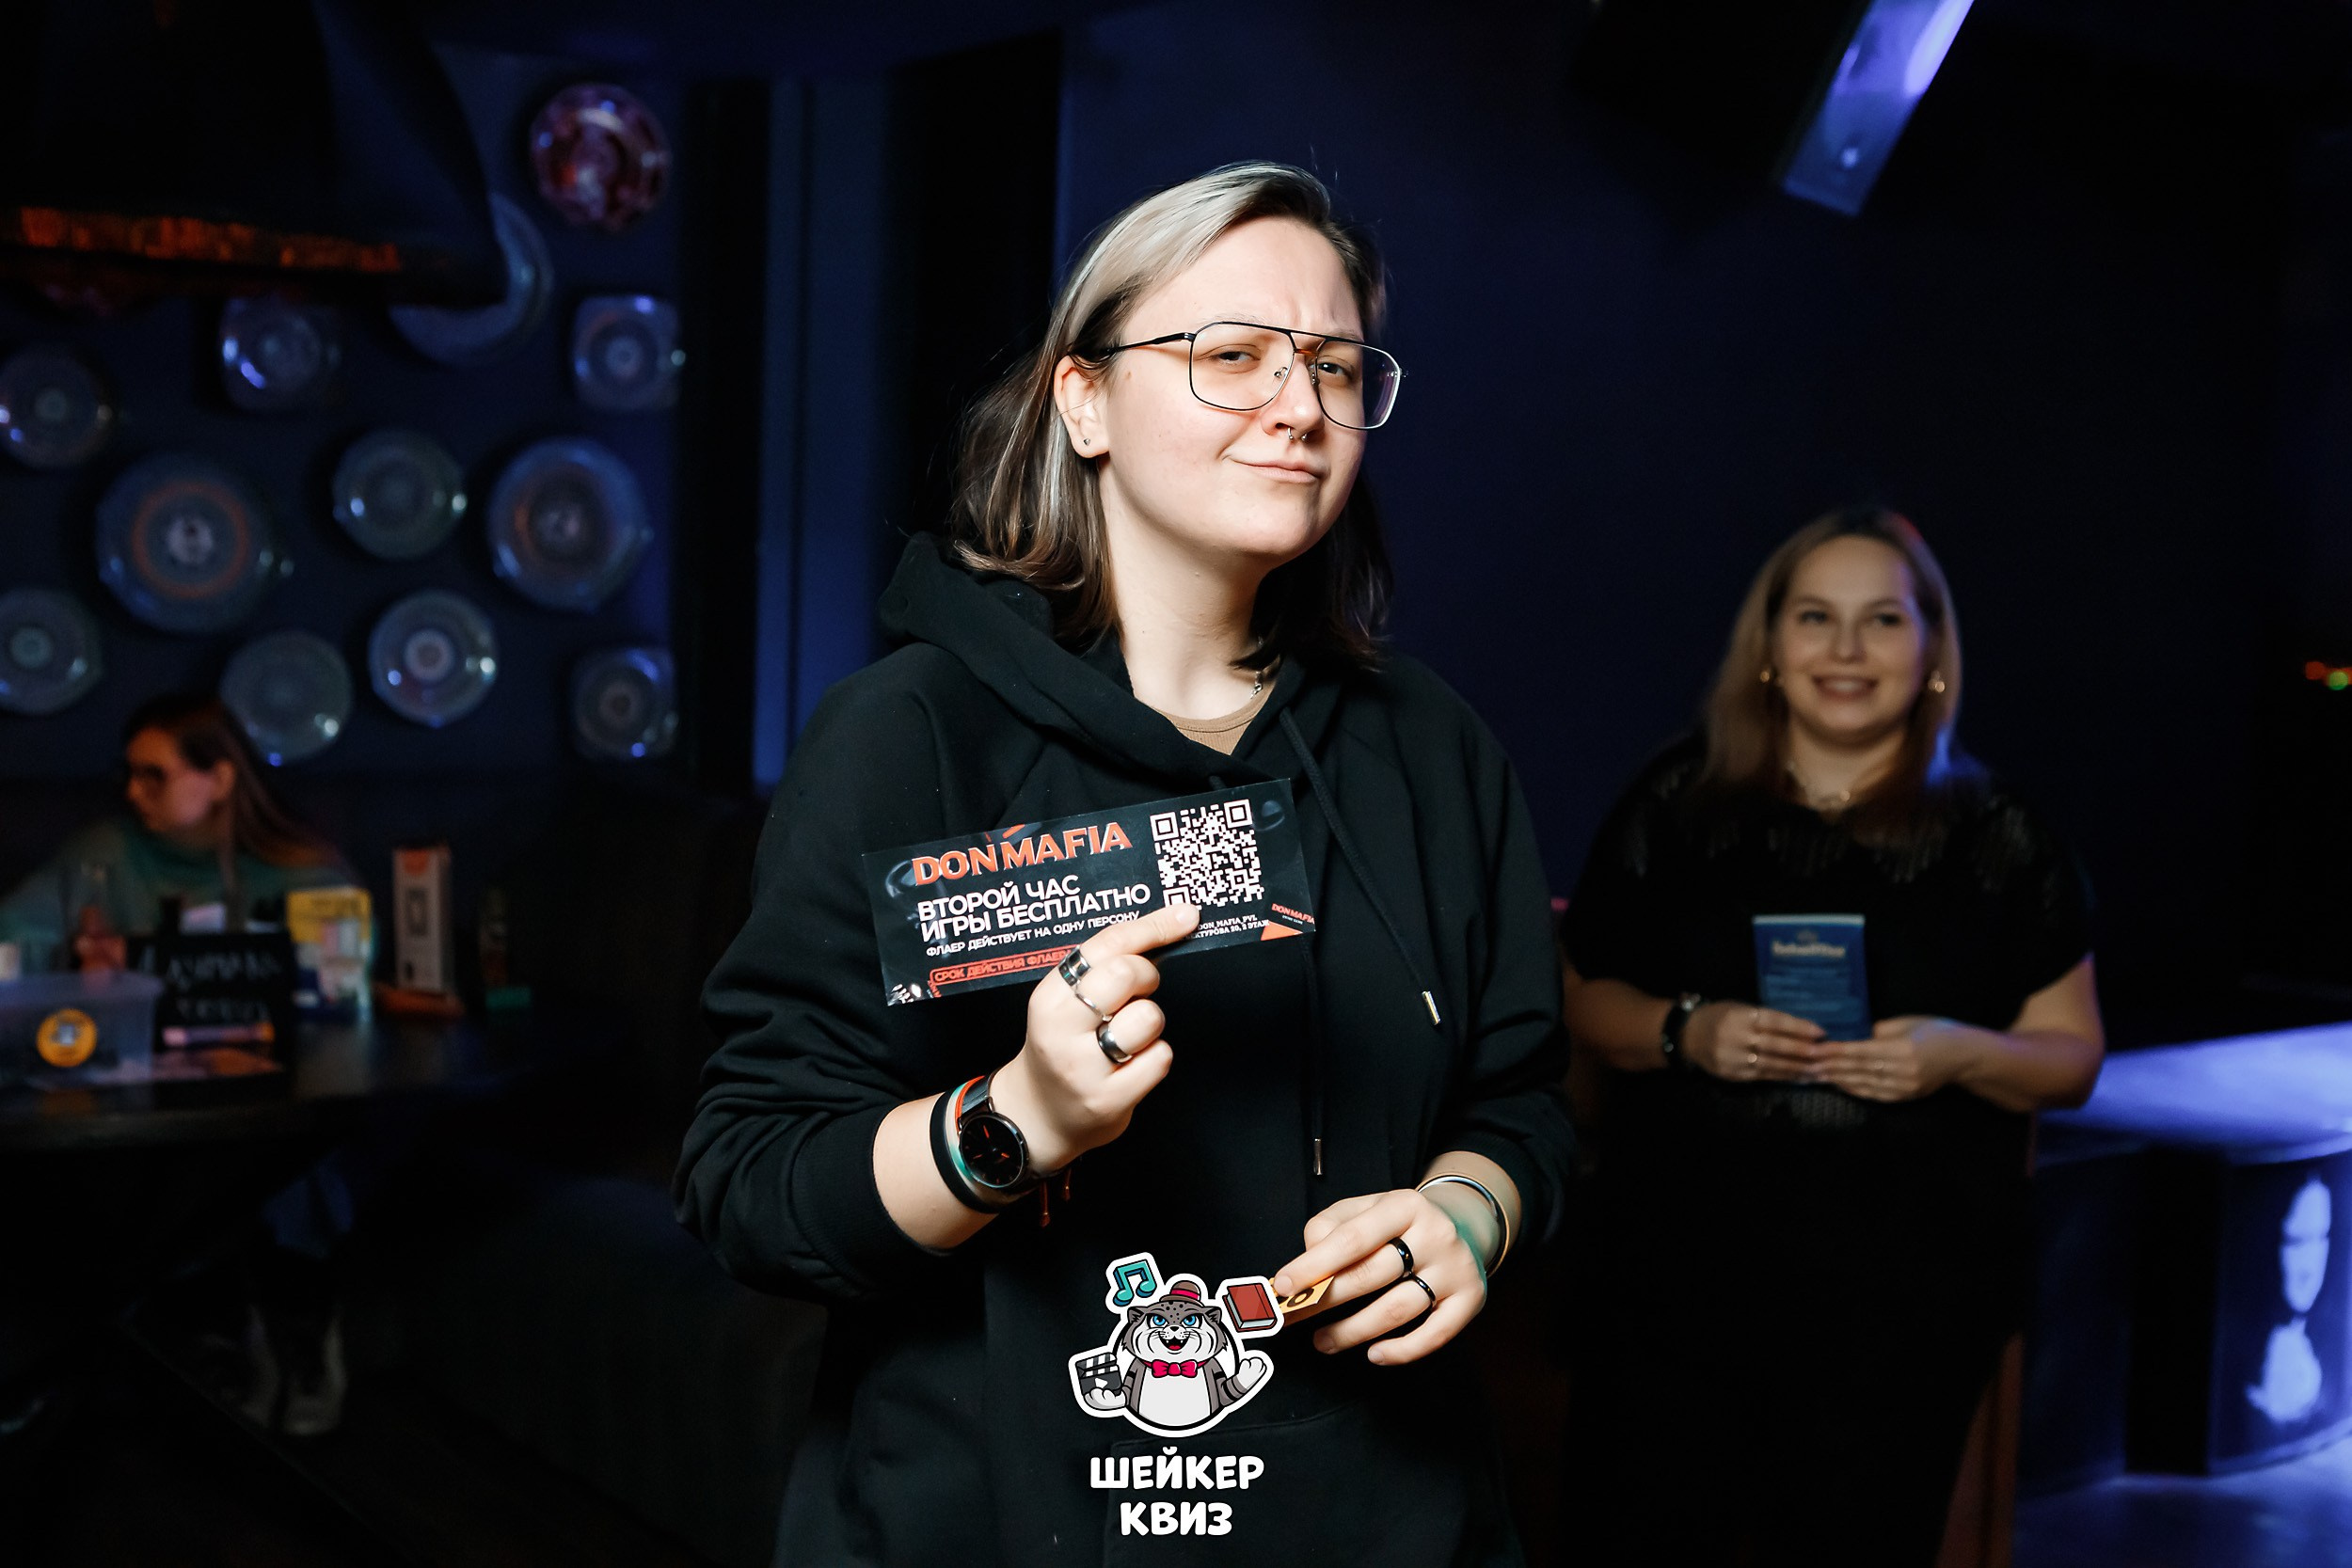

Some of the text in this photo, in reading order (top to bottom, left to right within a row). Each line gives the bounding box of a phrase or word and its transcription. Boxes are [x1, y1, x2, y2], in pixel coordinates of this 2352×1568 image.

[912, 821, 1133, 886] DON MAFIA
[917, 874, 1081, 922] ВТОРОЙ ЧАС
[920, 883, 1152, 942] ИГРЫ БЕСПЛАТНО
[1271, 903, 1291, 916] DON
[926, 911, 1140, 957] ФЛАЕР ДЕЙСТВУЕТ НА ОДНУ ПЕРСОНУ
[934, 970, 965, 982] СРОК
[966, 958, 1025, 977] ДЕЙСТВИЯ
